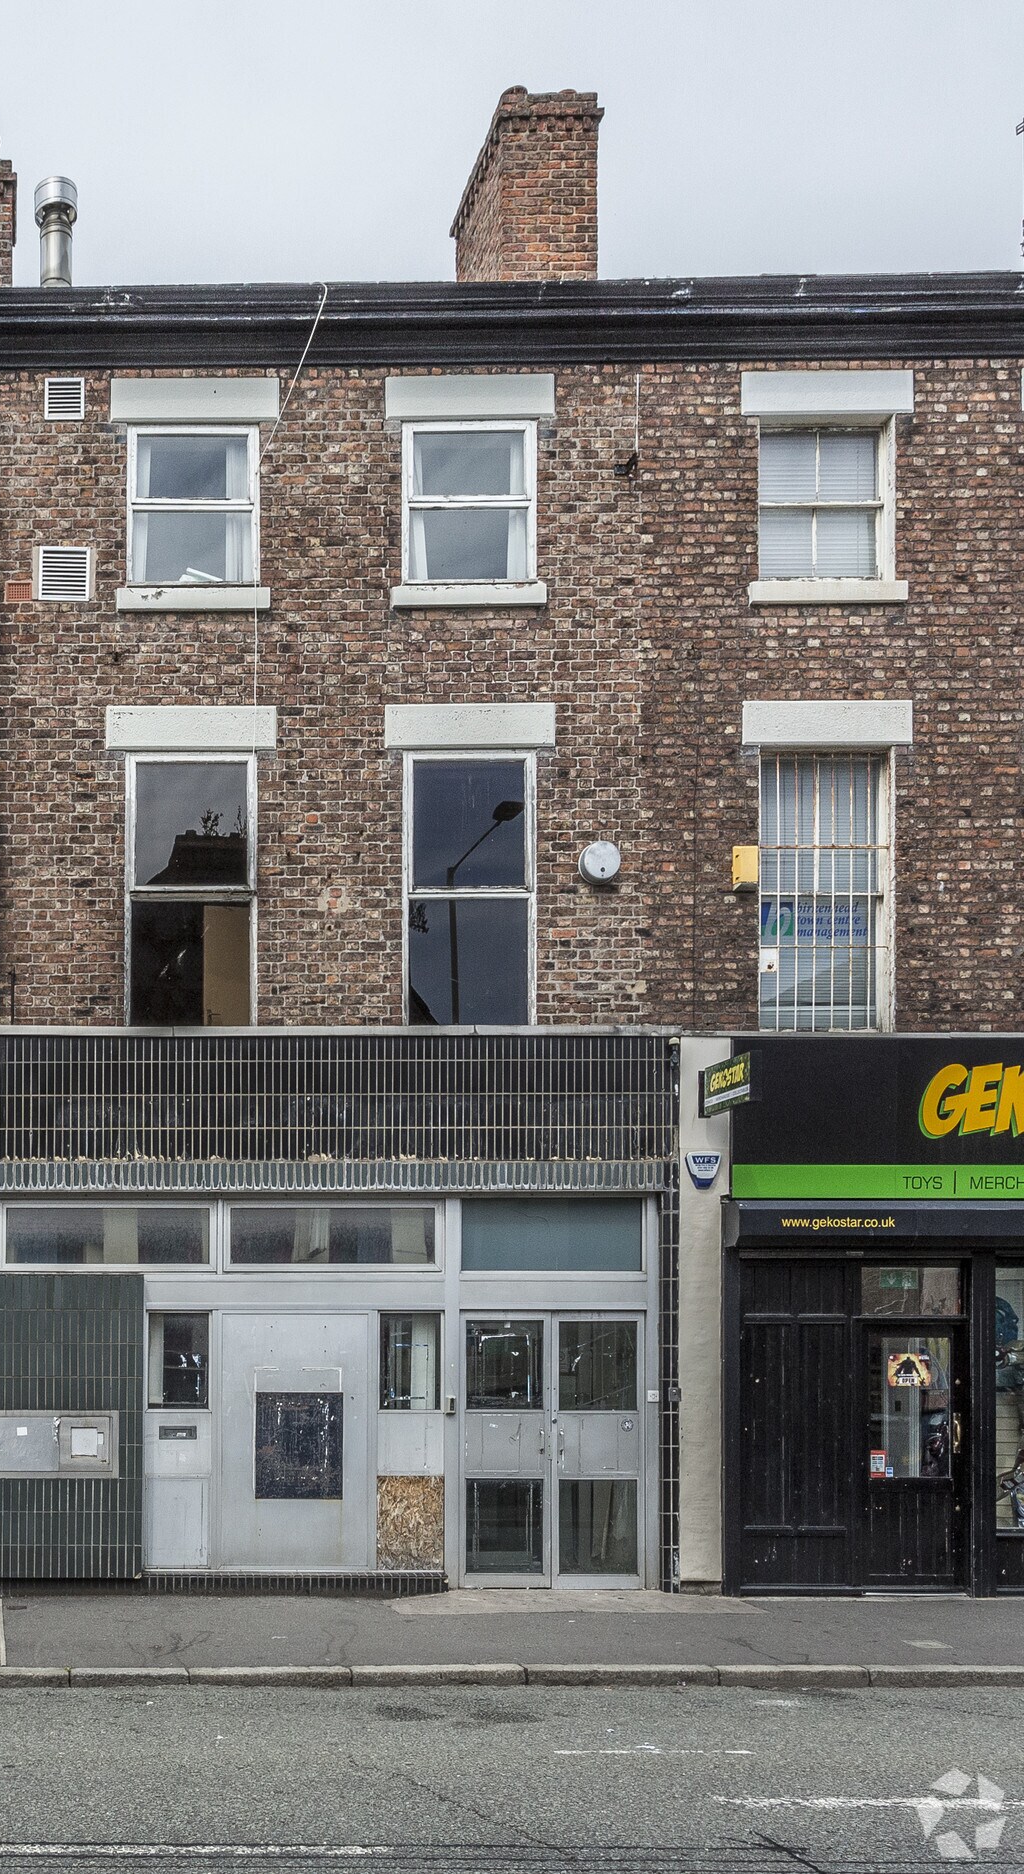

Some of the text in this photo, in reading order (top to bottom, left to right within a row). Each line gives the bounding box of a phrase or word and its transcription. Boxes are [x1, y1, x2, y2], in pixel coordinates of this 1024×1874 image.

[797, 916, 823, 925] town
[710, 1063, 744, 1092] GEKOSTAR
[903, 1176, 943, 1190] TOYS
[781, 1217, 895, 1230] www.gekostar.co.uk
